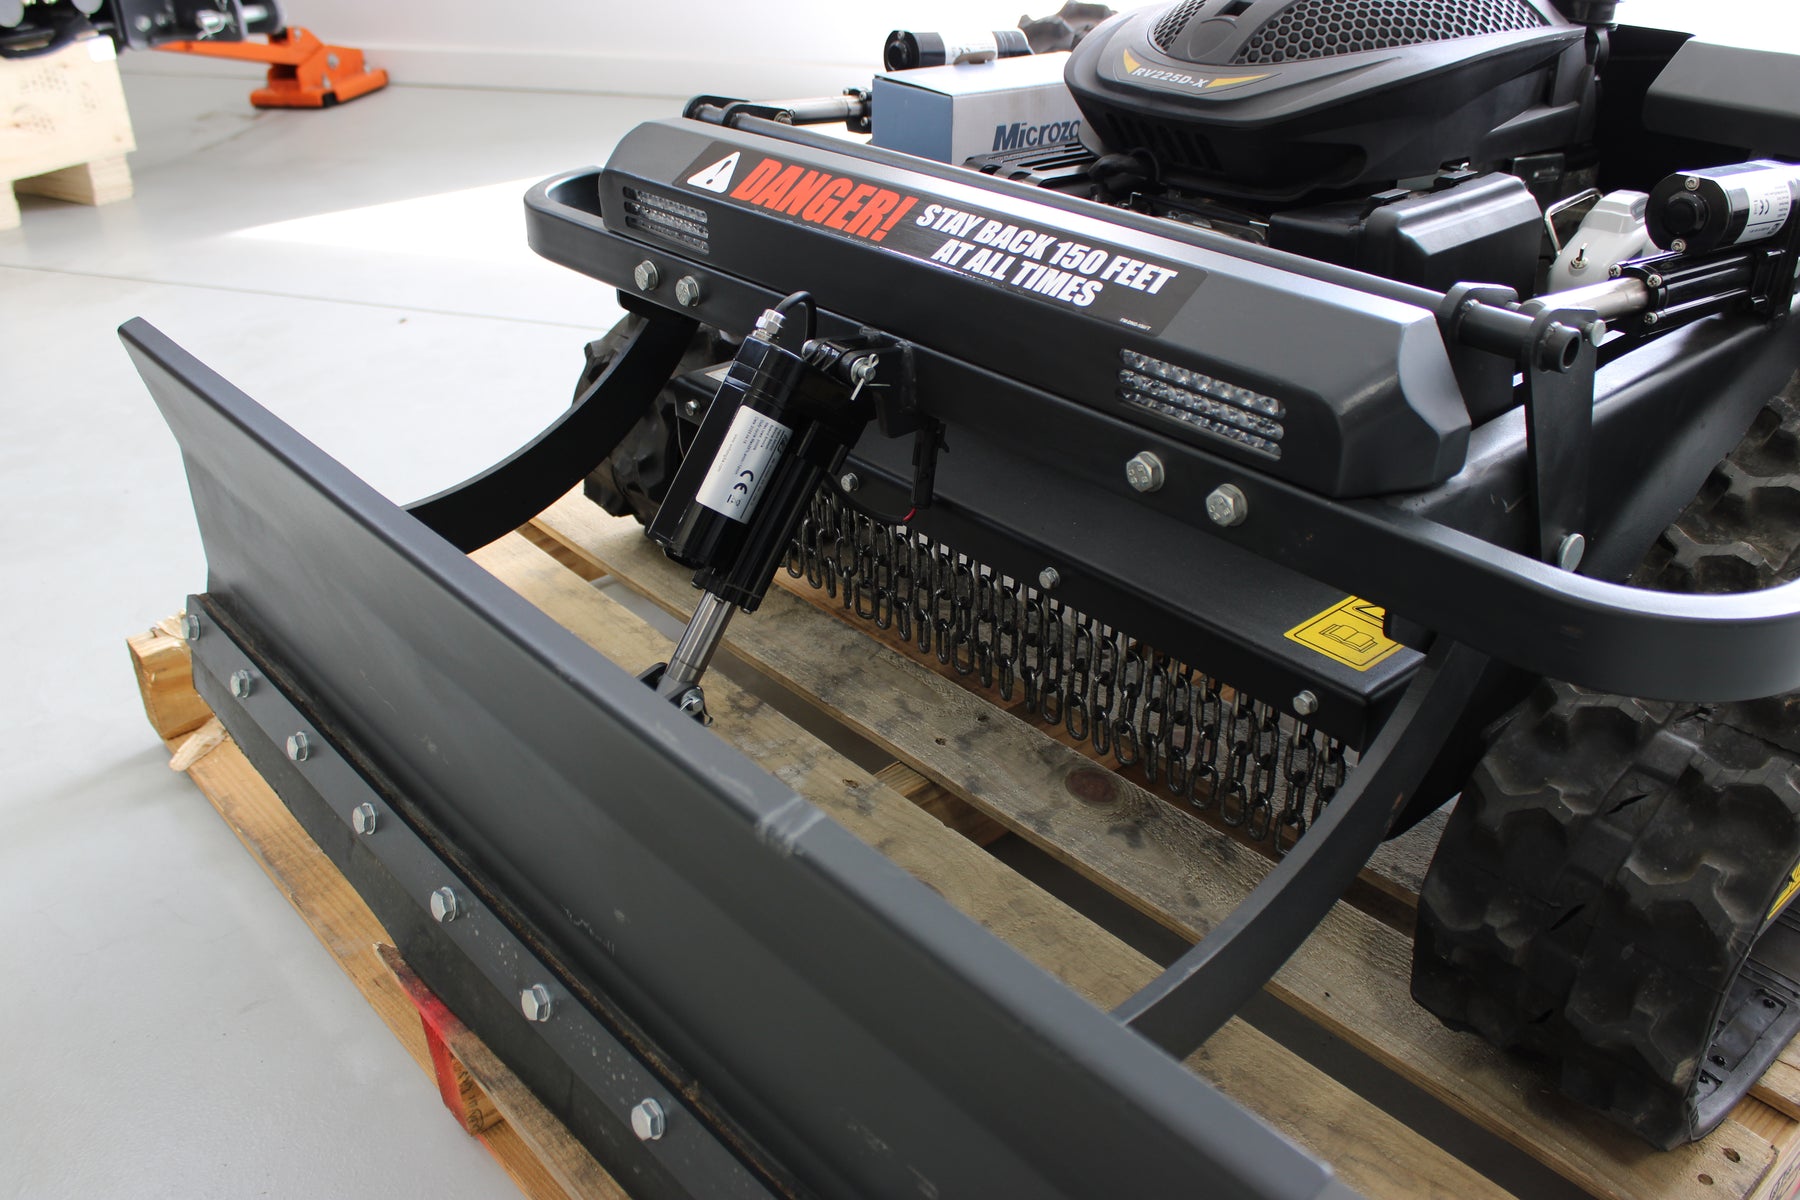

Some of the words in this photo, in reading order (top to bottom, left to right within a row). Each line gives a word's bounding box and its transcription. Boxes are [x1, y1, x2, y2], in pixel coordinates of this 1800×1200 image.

[1131, 67, 1210, 88] RV225D-X
[729, 157, 920, 242] DANGER!
[915, 204, 985, 239] STAY
[972, 219, 1057, 261] BACK
[1049, 241, 1109, 275] 150
[1100, 255, 1179, 295] FEET
[930, 238, 977, 266] AT
[962, 248, 1017, 281] ALL
[1010, 260, 1104, 307] TIMES
